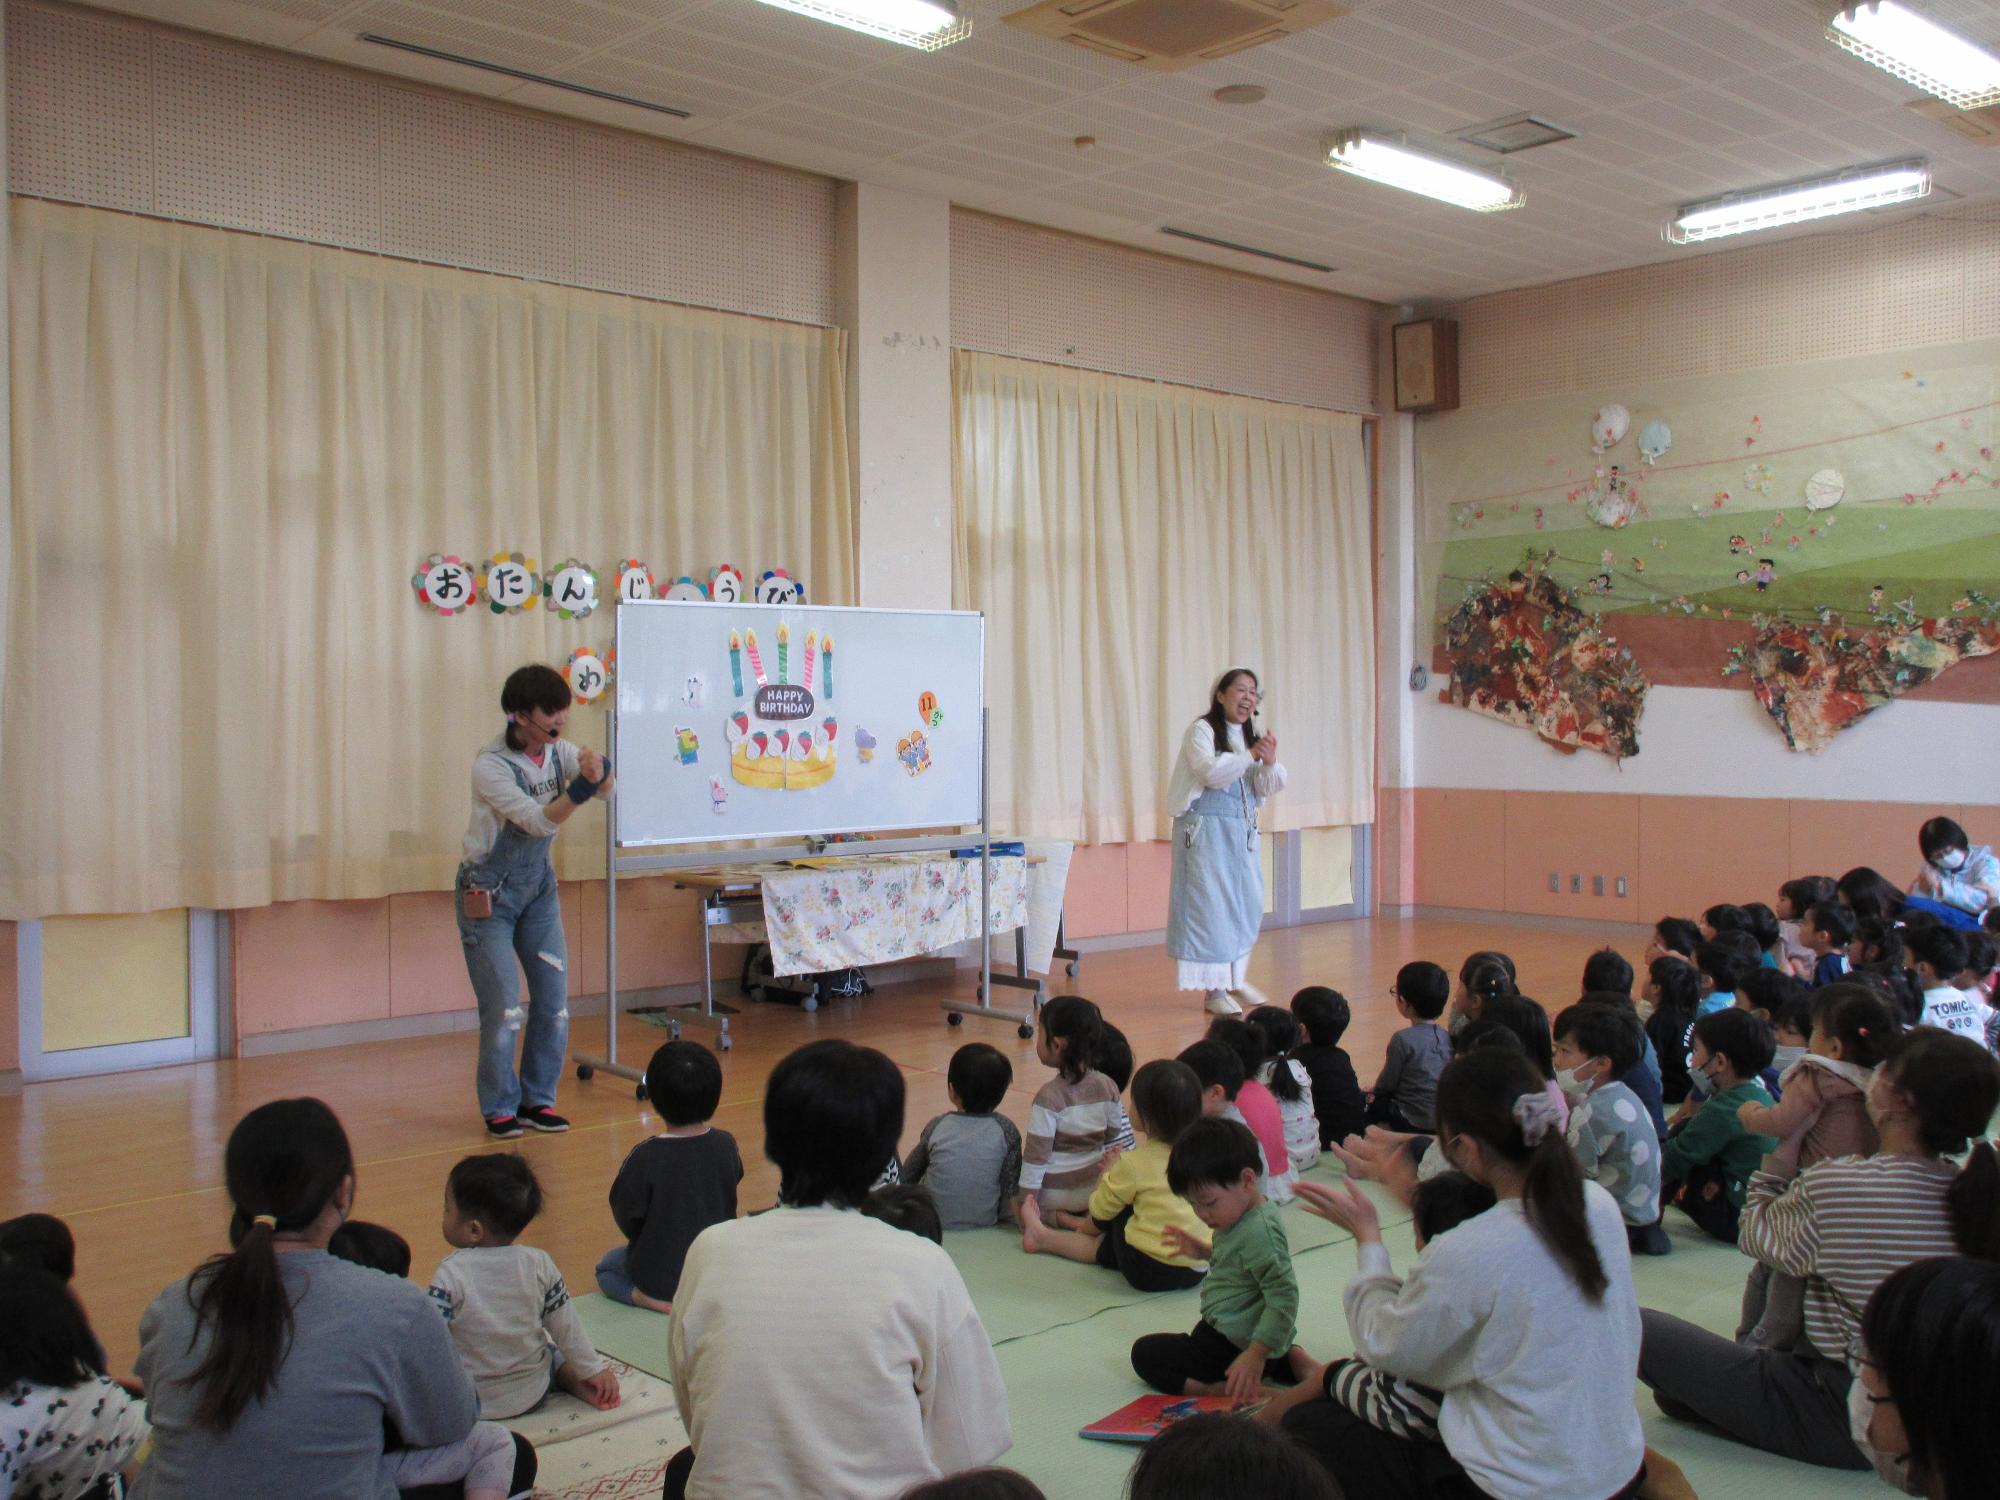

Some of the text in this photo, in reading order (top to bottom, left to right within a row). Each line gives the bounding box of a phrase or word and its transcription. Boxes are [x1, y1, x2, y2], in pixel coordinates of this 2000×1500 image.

[767, 690, 804, 702] HAPPY
[759, 702, 811, 714] BIRTHDAY
[1930, 1000, 1974, 1016] TOMIC
